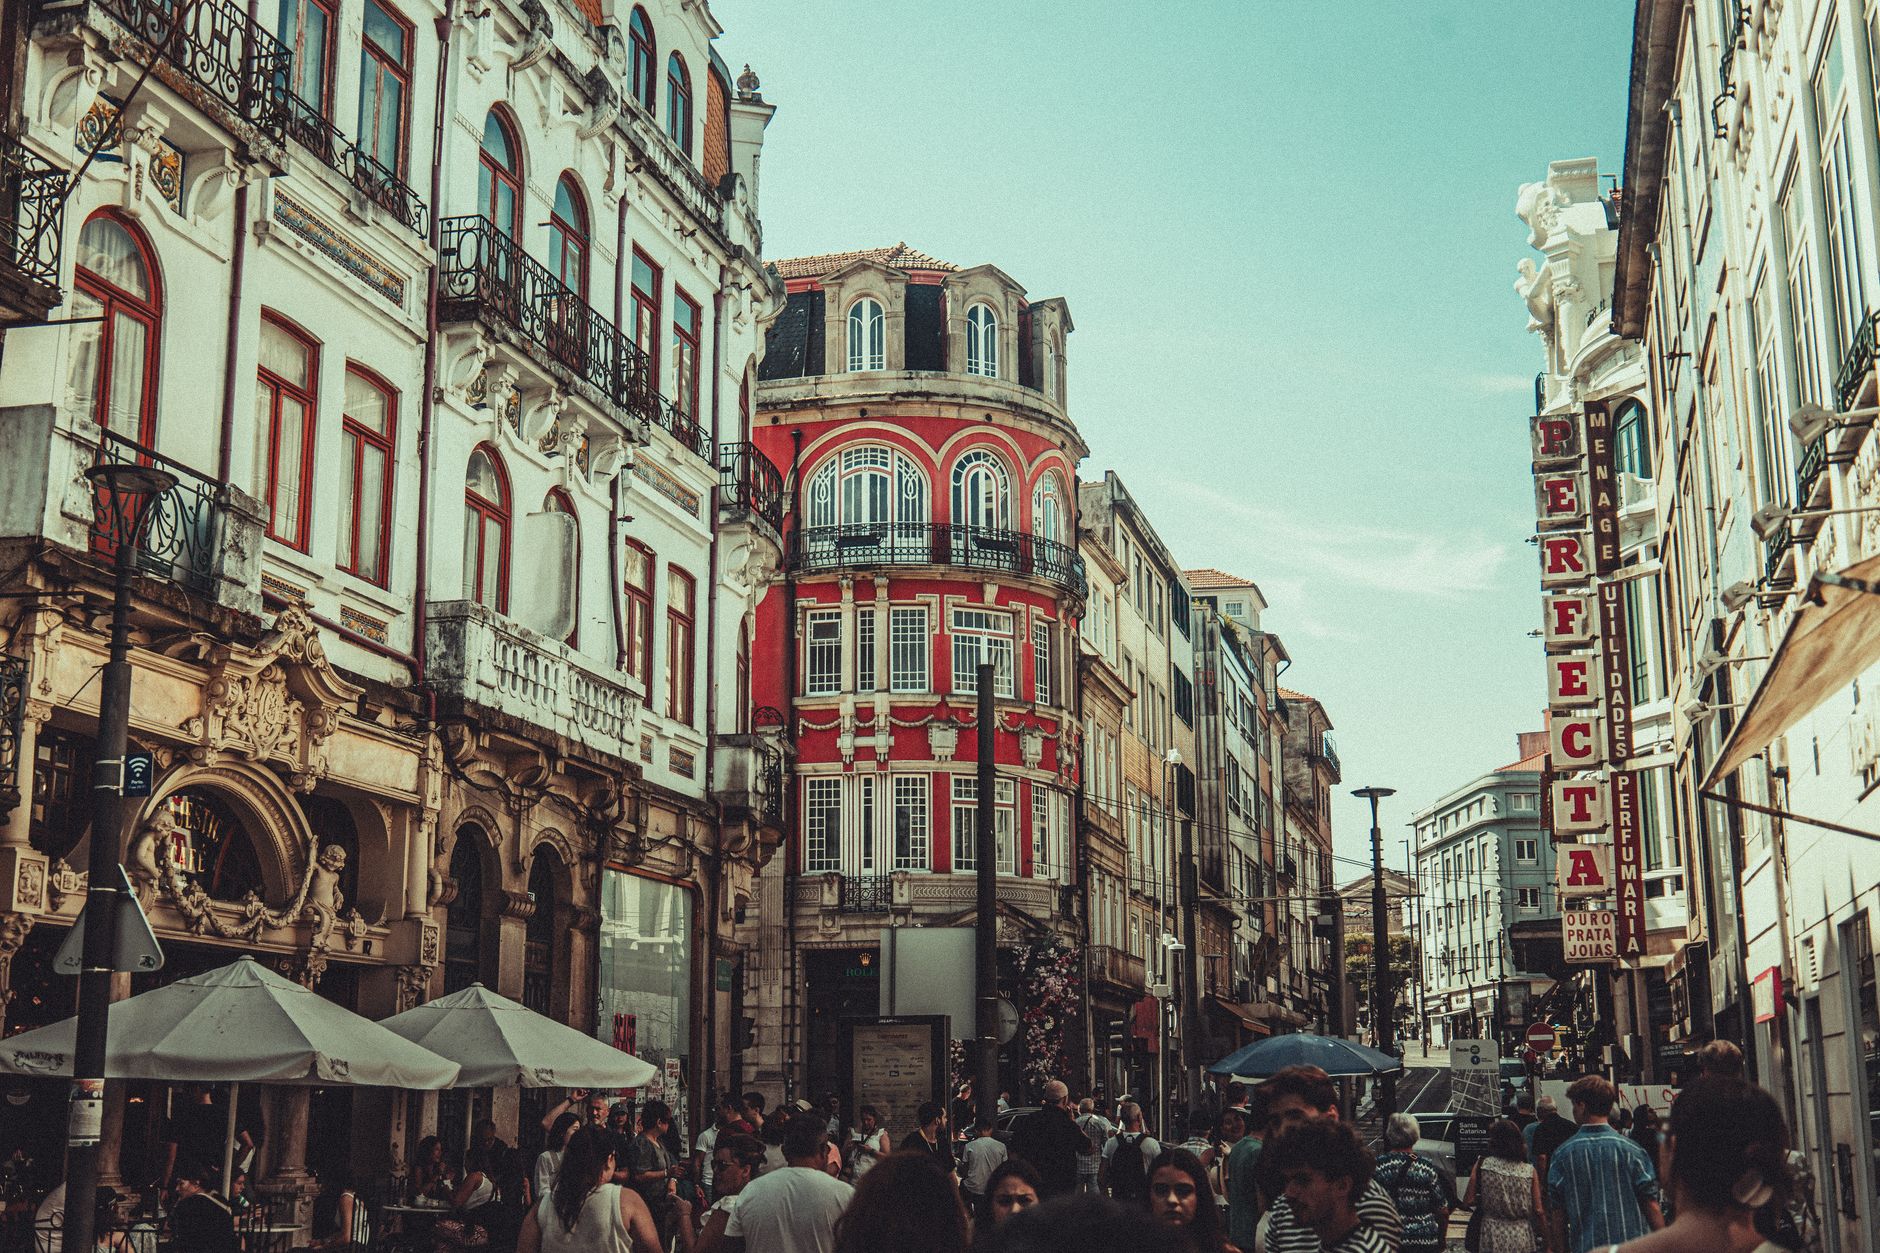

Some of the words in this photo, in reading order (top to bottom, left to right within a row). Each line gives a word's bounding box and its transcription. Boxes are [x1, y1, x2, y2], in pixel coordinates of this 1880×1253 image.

[1589, 413, 1613, 560] MENAGE
[1538, 420, 1604, 887] PERFECTA
[1604, 586, 1627, 758] UTILIDADES
[1566, 912, 1611, 926] OURO
[1567, 927, 1612, 941] PRATA
[1617, 775, 1640, 953] PERFUMARIA
[1569, 943, 1613, 957] JOIAS
